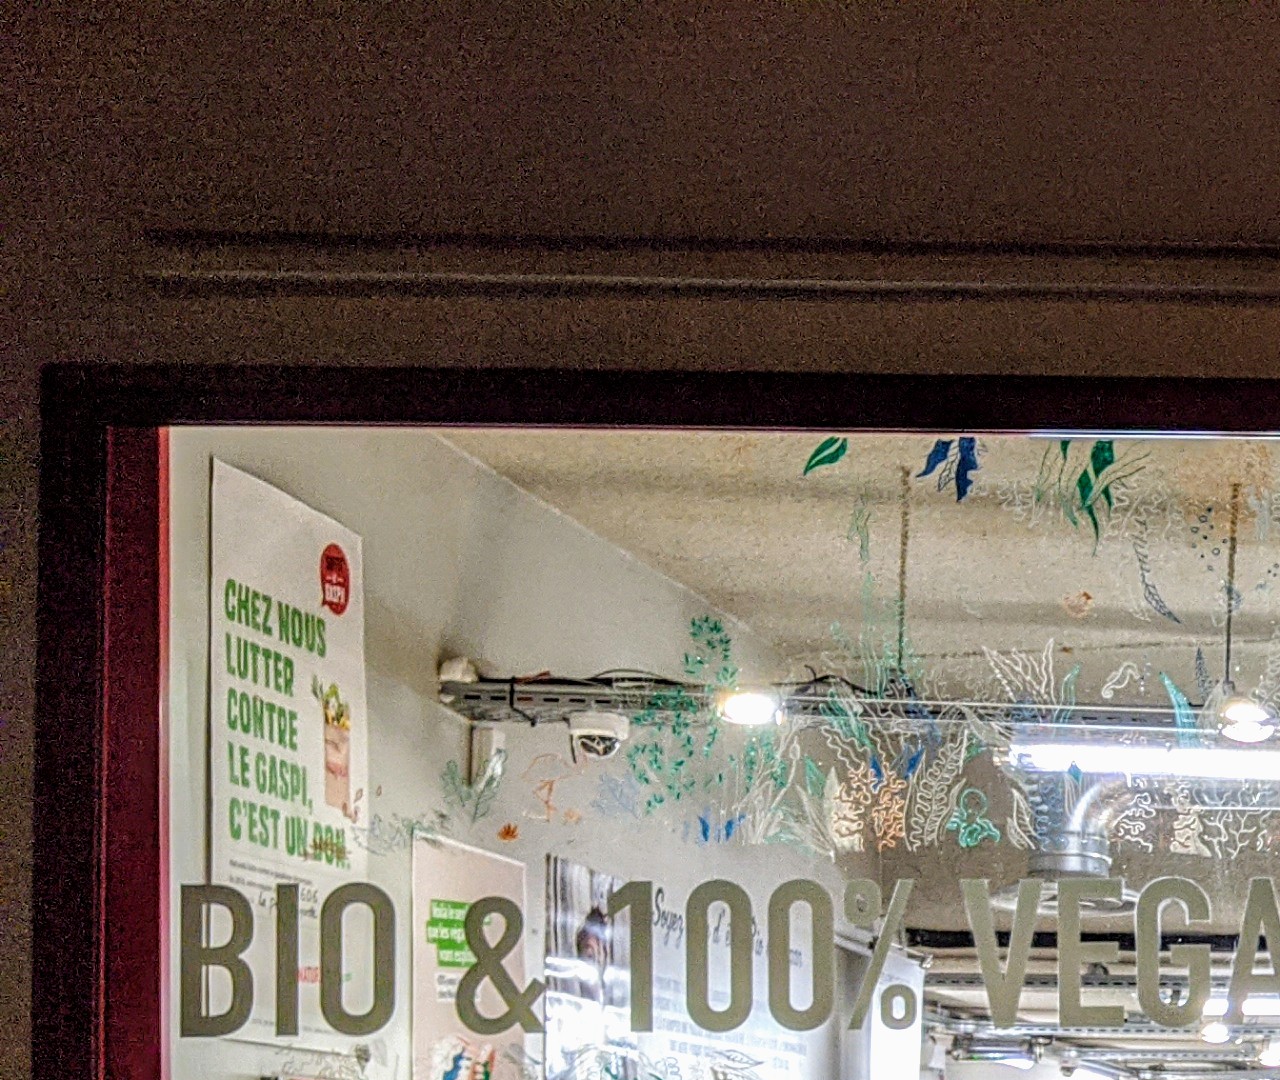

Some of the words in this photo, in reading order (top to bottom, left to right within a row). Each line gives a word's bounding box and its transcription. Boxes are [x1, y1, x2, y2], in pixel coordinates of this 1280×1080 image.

[225, 578, 273, 637] CHEZ
[278, 600, 327, 658] NOUS
[226, 632, 294, 698] LUTTER
[227, 687, 298, 752] CONTRE
[228, 740, 250, 789] LE
[229, 796, 280, 850] C'EST
[285, 814, 309, 859] UN
[179, 881, 396, 1037] BIO
[455, 895, 548, 1035] &
[607, 878, 917, 1033] 100%
